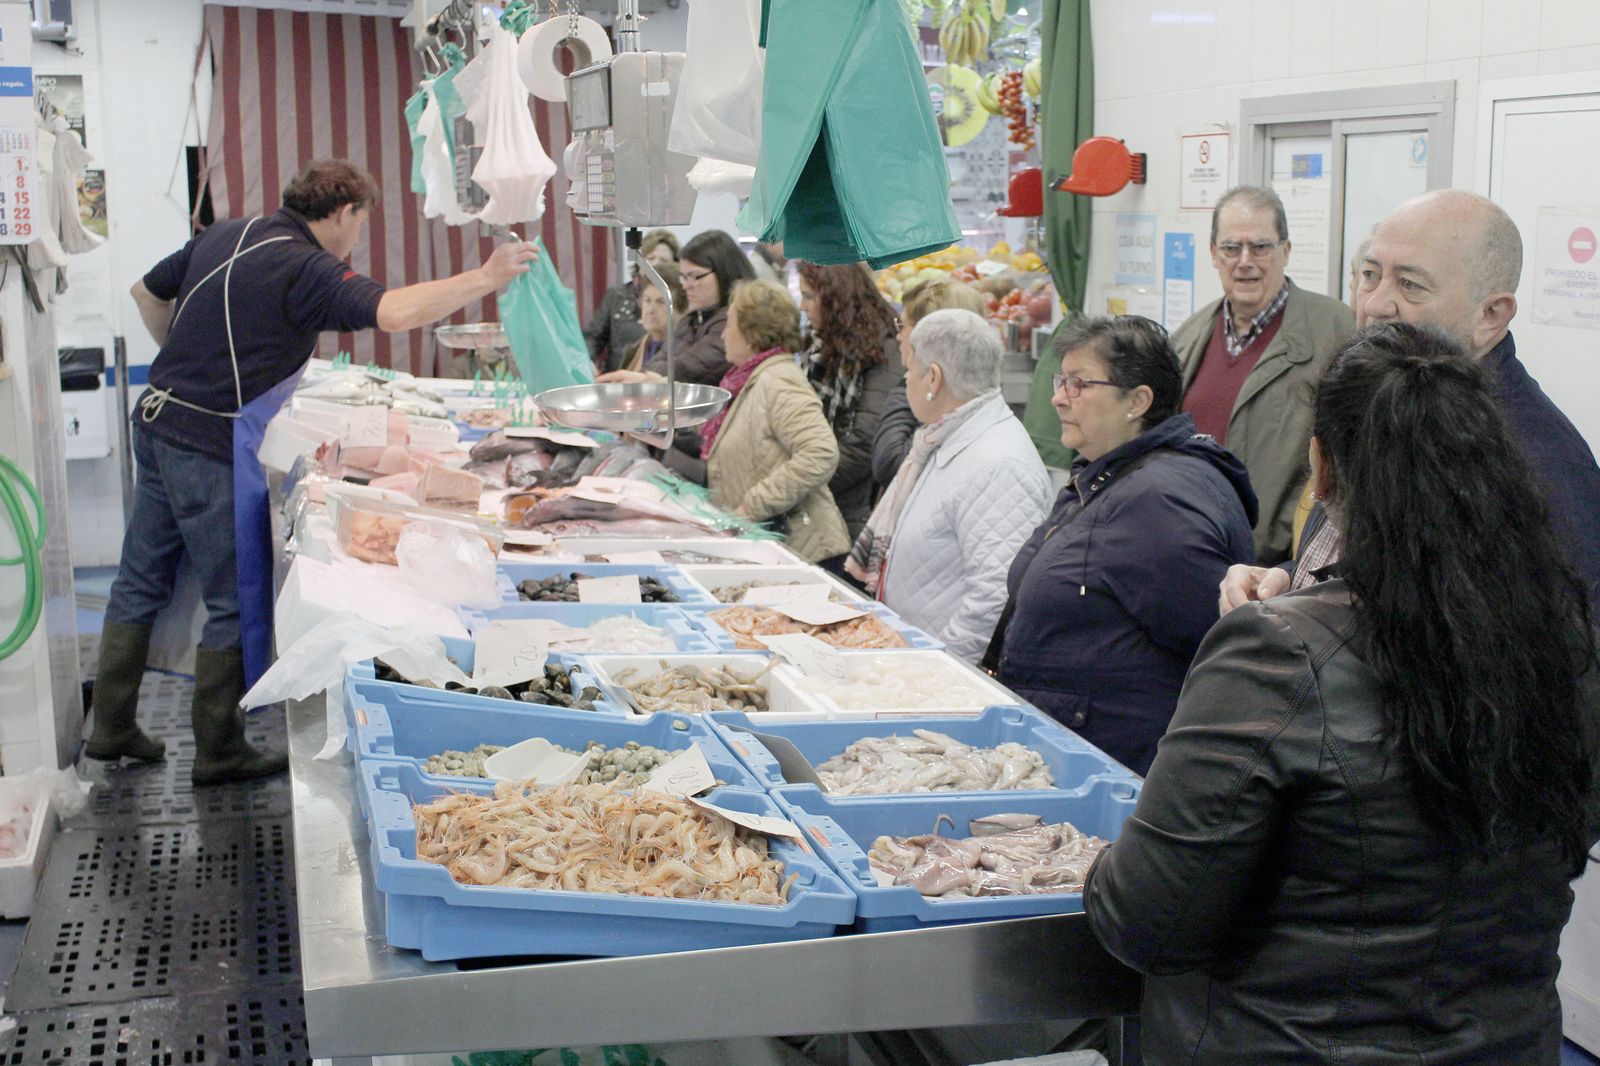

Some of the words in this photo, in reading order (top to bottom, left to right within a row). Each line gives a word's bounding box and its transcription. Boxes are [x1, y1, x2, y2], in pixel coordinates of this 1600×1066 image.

[16, 176, 25, 188] 8
[14, 192, 29, 204] 15
[14, 207, 30, 220] 22
[15, 223, 31, 236] 29
[1545, 268, 1586, 280] PROHIBIDO
[1587, 271, 1598, 281] EL
